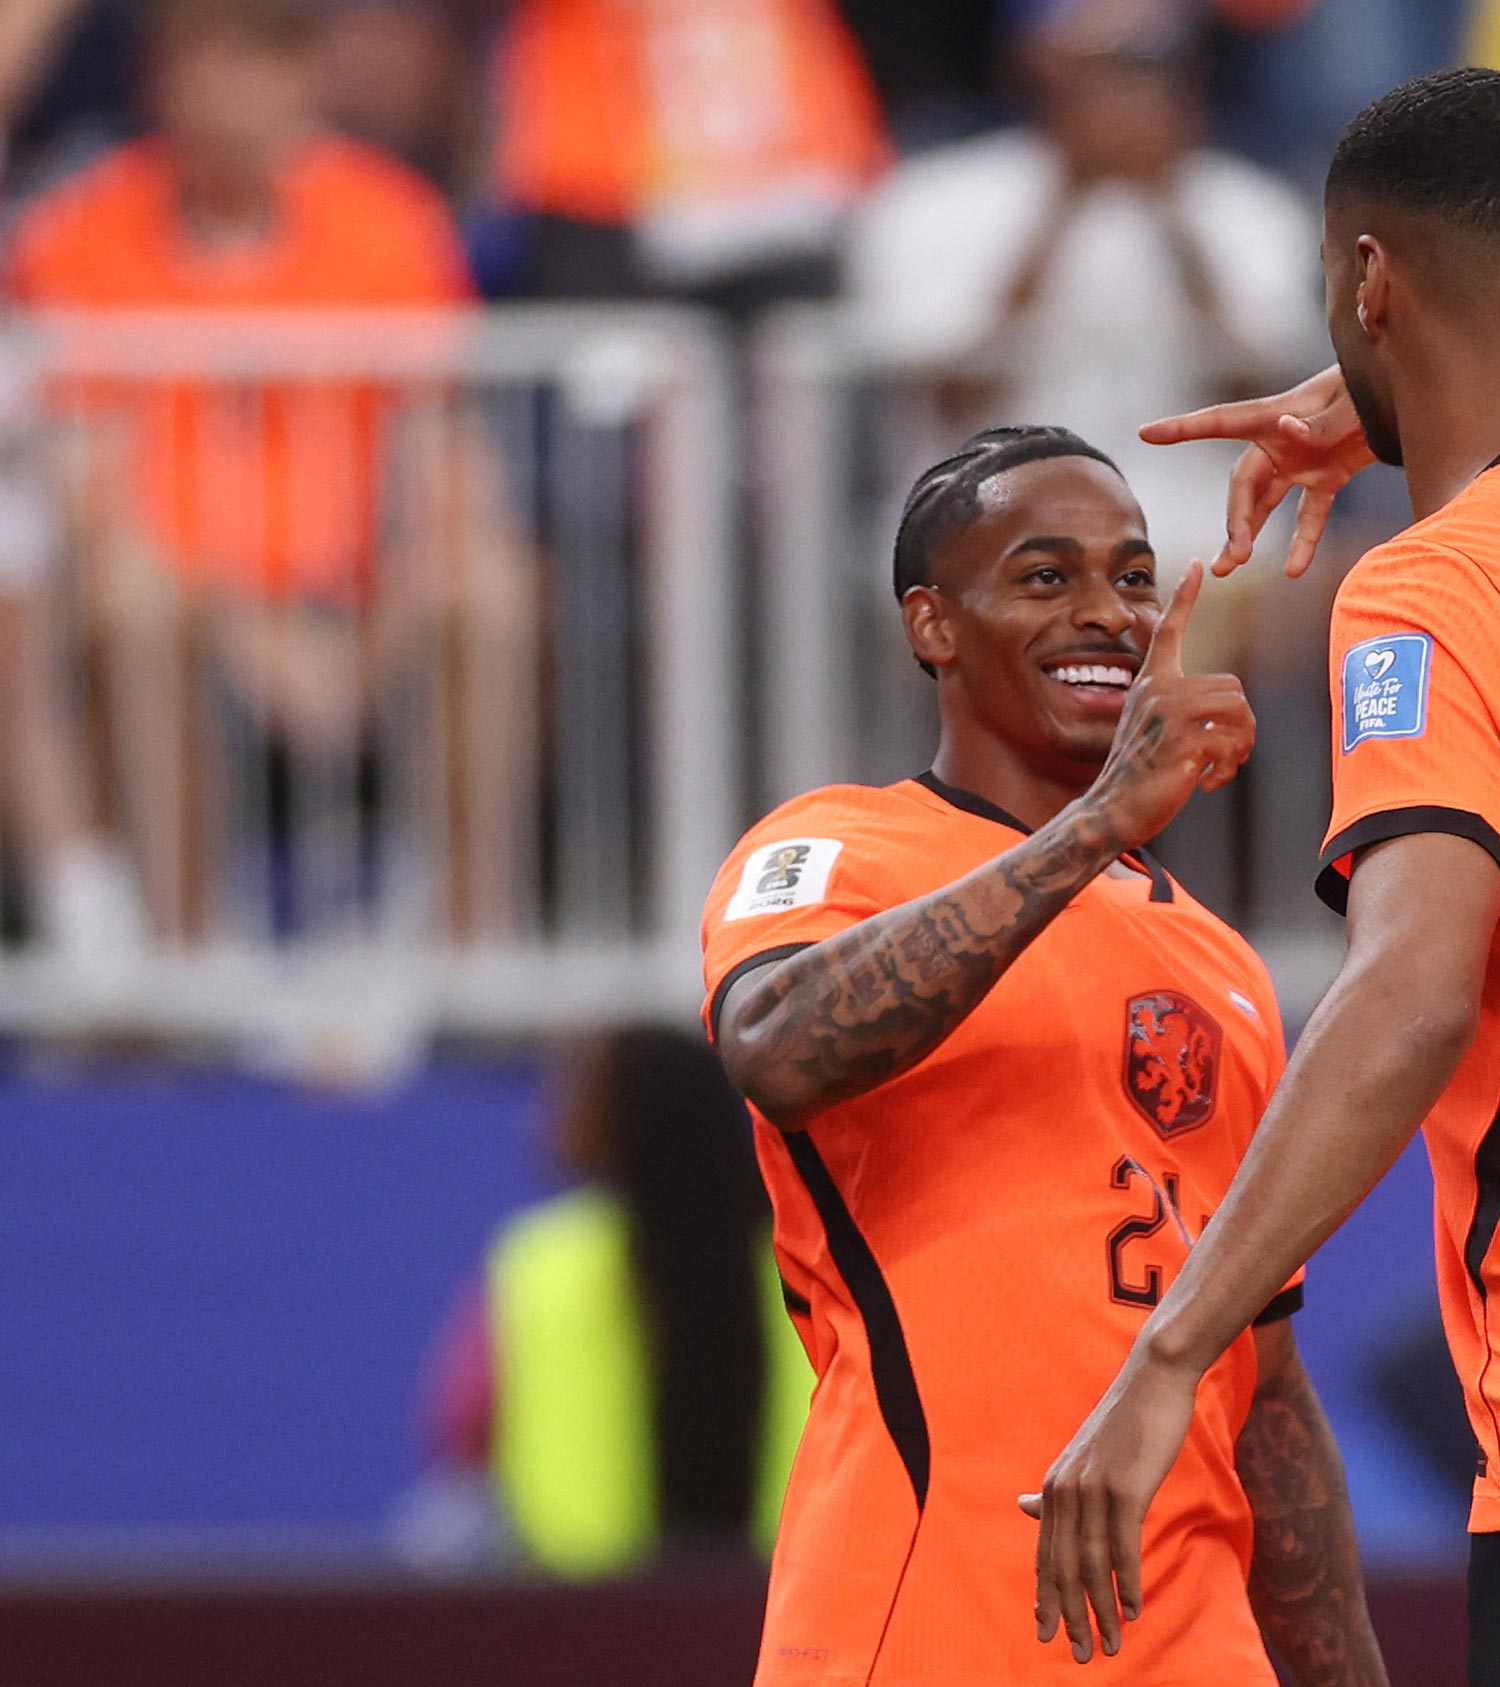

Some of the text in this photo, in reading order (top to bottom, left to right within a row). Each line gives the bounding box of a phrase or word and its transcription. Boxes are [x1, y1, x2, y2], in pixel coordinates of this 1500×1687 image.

[1382, 677, 1403, 697] For
[1354, 697, 1398, 723] PEACE
[1359, 718, 1386, 731] FIFA
